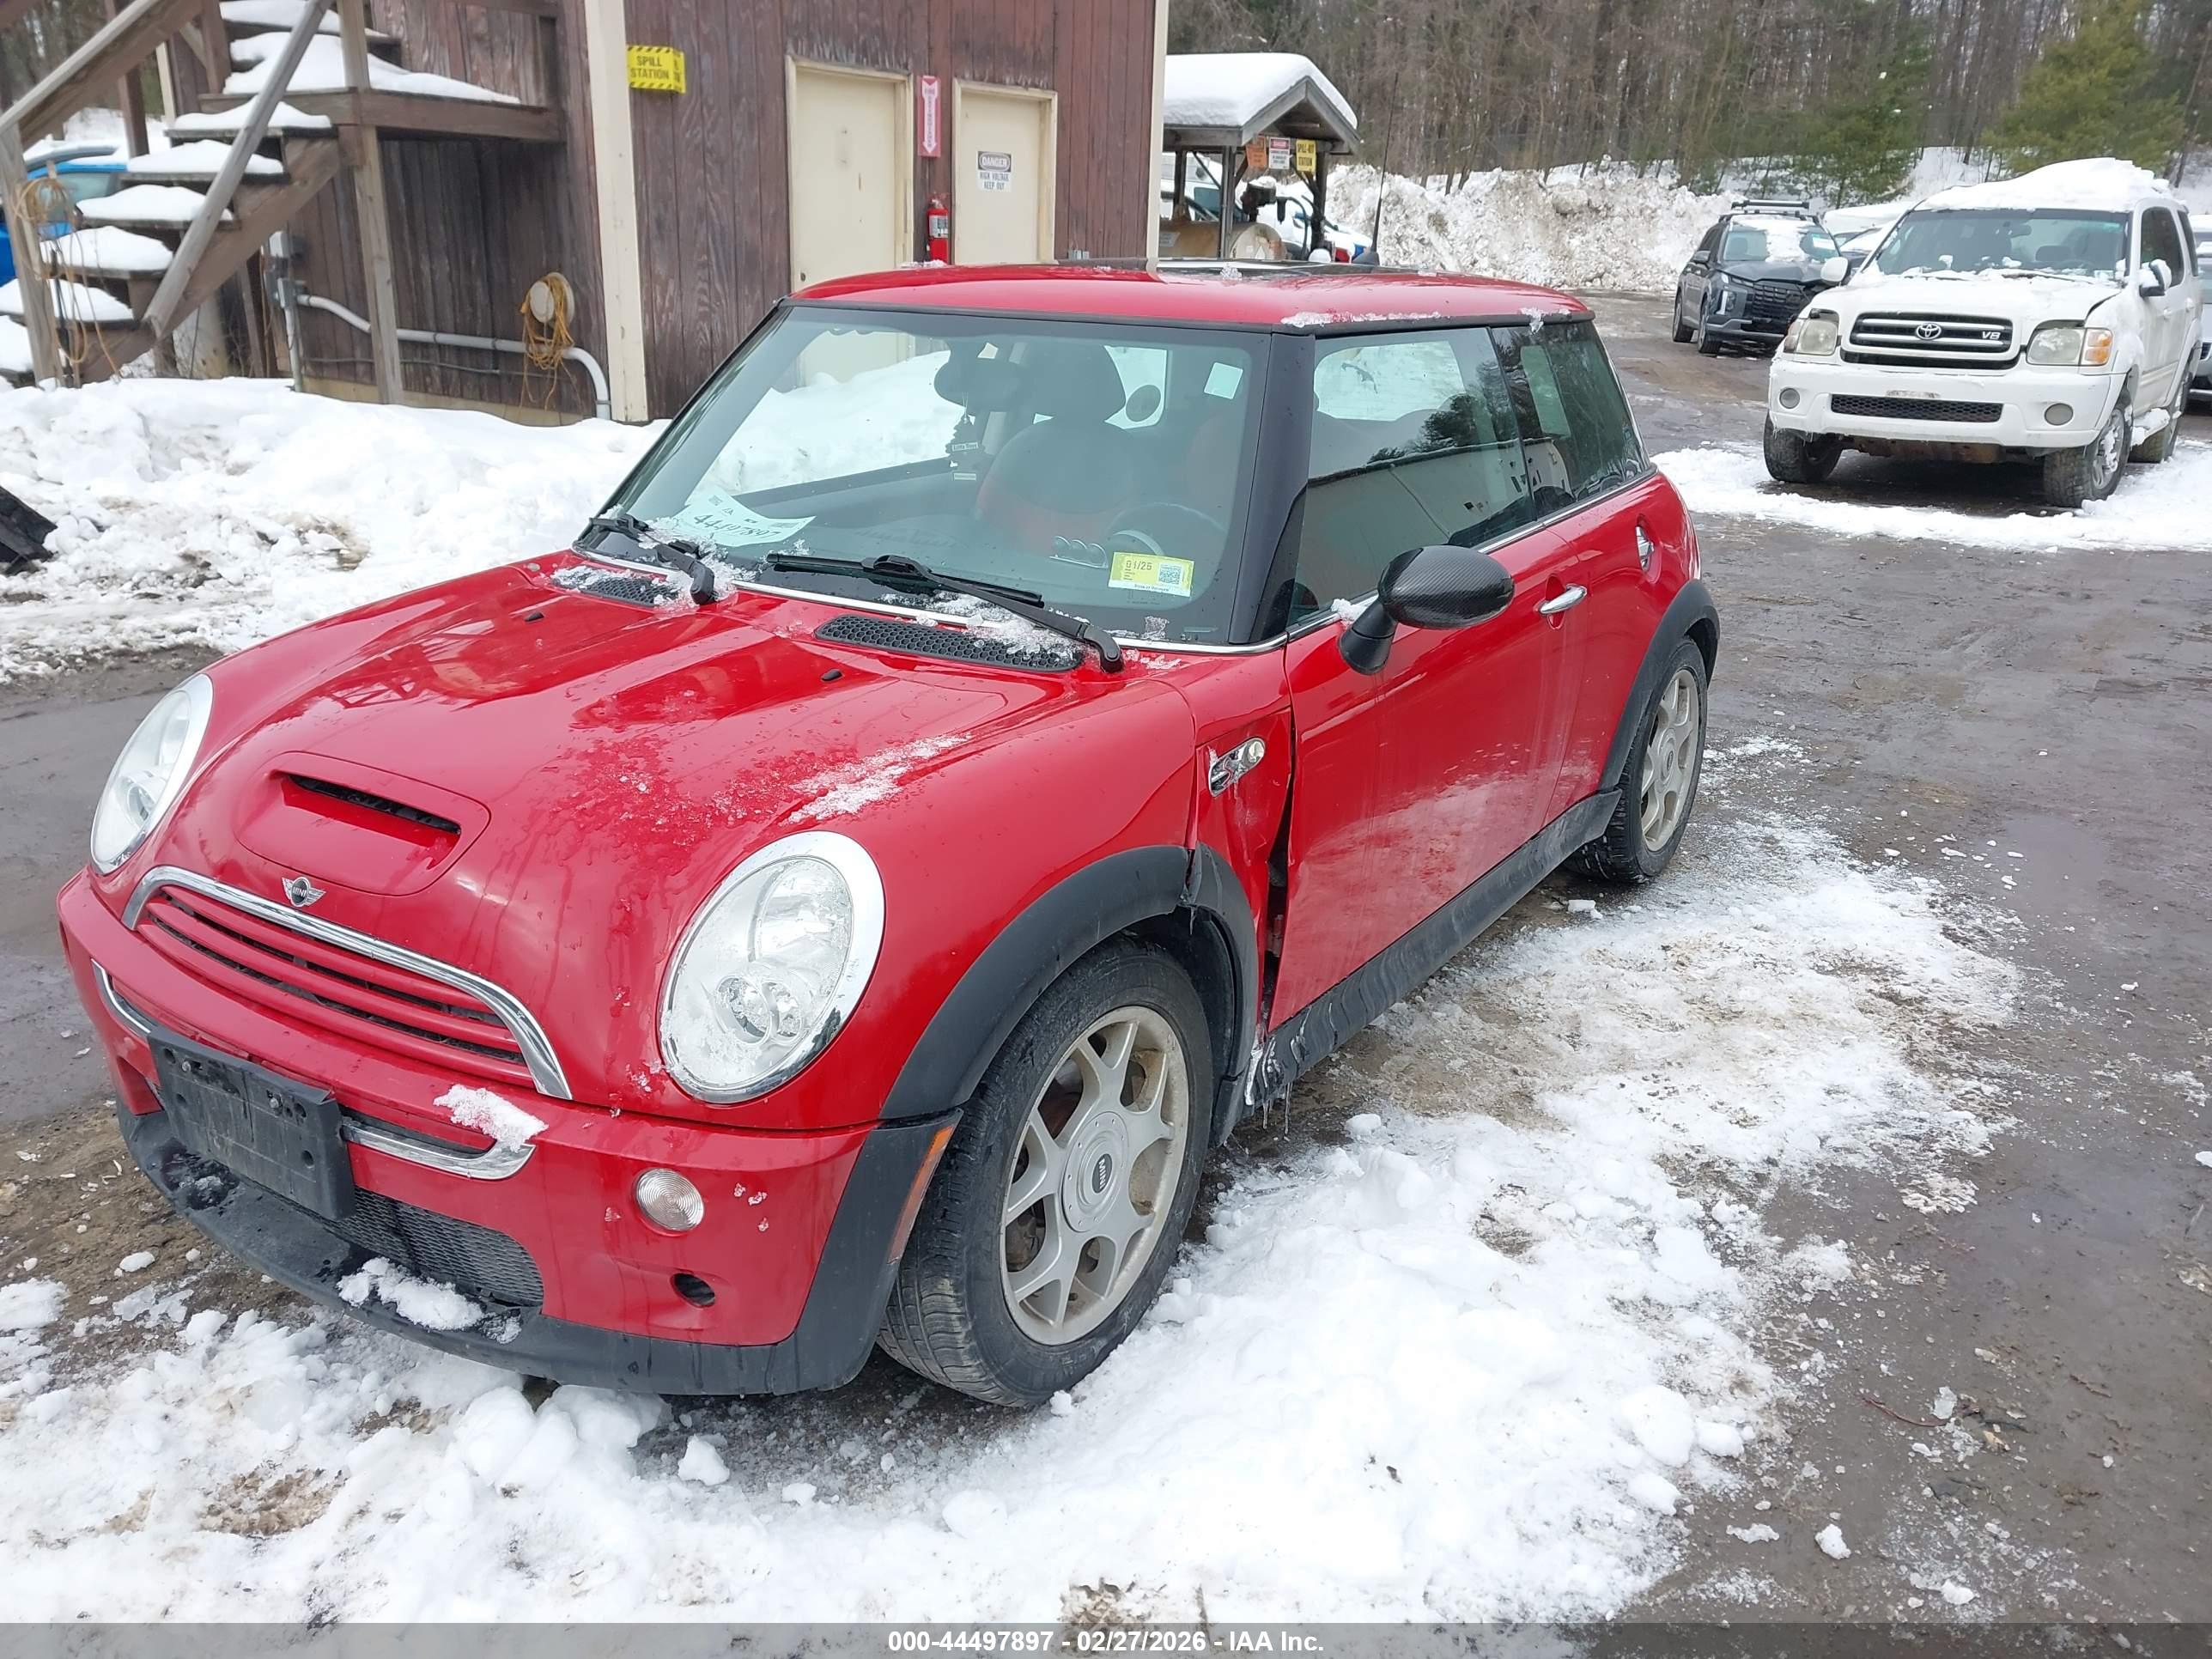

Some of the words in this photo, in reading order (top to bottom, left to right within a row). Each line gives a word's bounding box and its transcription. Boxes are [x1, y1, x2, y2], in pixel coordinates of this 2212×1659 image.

[636, 55, 663, 67] SPILL
[630, 68, 669, 79] STATION
[981, 156, 1007, 167] DANGER
[1981, 331, 2001, 340] V8
[293, 886, 307, 897] MINI
